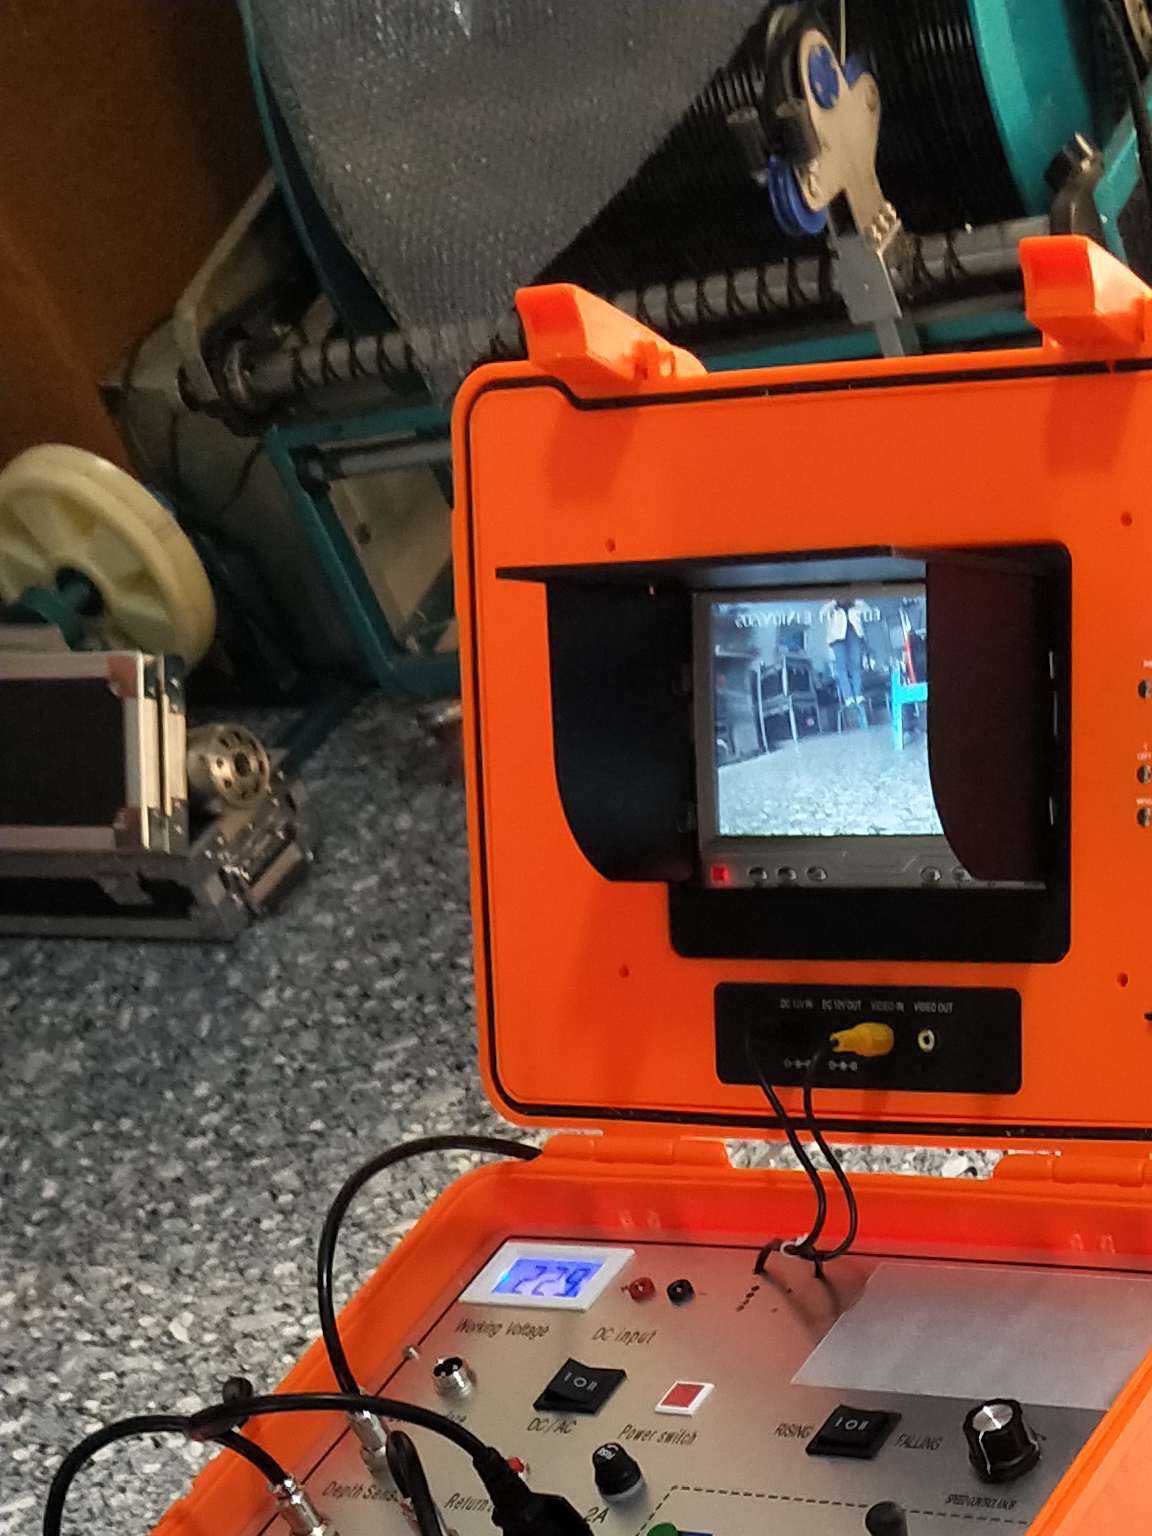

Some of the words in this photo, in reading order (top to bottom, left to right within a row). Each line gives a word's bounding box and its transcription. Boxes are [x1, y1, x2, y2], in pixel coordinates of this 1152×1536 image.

[455, 1318, 503, 1339] Working
[505, 1321, 550, 1341] Voltage
[592, 1326, 615, 1341] DC
[614, 1327, 657, 1346] input
[617, 1423, 658, 1442] Power
[656, 1428, 698, 1445] switch
[774, 1422, 815, 1440] RISING
[895, 1433, 943, 1451] FALLING
[322, 1480, 363, 1501] Depth
